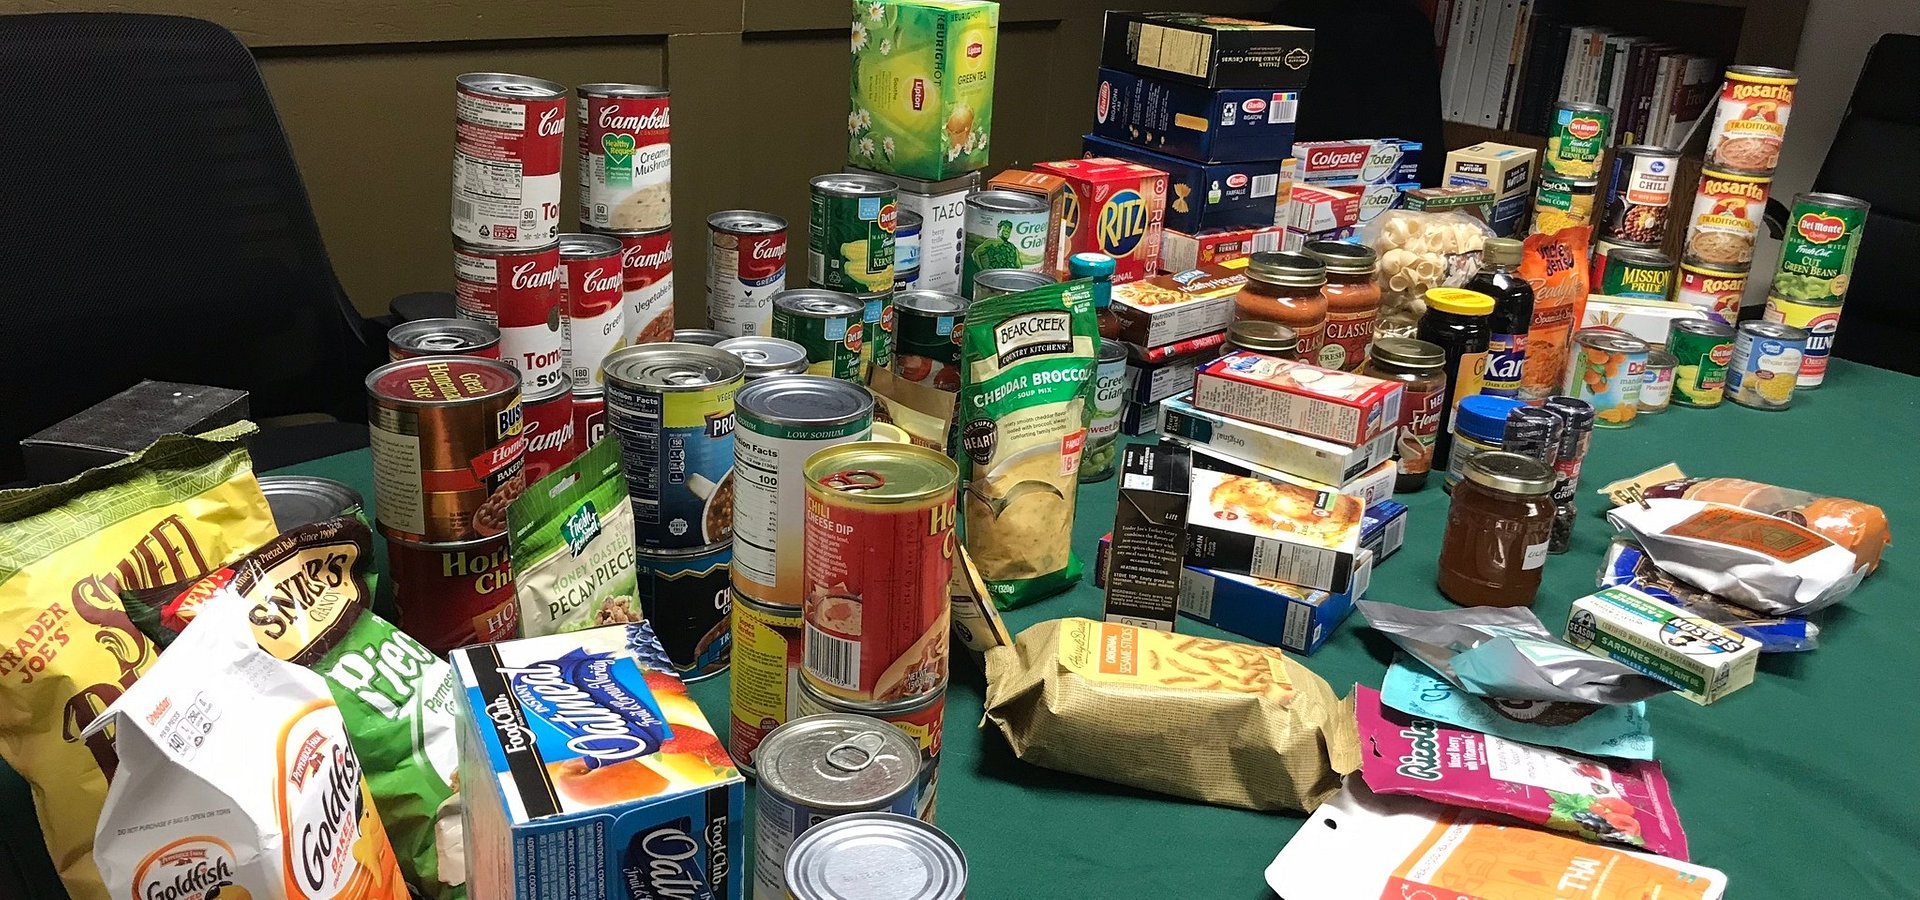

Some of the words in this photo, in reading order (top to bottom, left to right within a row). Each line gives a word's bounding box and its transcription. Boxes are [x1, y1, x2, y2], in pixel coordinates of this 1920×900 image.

[968, 46, 982, 54] Lipton
[958, 73, 976, 85] GREEN
[977, 71, 987, 81] TEA
[914, 81, 923, 108] Lipton
[1733, 84, 1793, 103] Rosarita
[1110, 88, 1118, 121] RIGATONI
[1730, 122, 1782, 132] TRADITIONAL
[606, 140, 629, 148] Healthy
[1312, 151, 1363, 167] Colgate
[1369, 152, 1396, 165] Total
[1155, 178, 1165, 194] 8
[1226, 188, 1246, 196] FARFALLE
[1639, 181, 1667, 191] CHILI
[1705, 180, 1764, 199] Rosarita
[1364, 194, 1393, 205] Total
[524, 210, 533, 219] 90
[933, 202, 965, 222] TAZO
[1099, 198, 1147, 248] RITZ
[1147, 197, 1163, 256] FRESH
[1701, 216, 1752, 228] TRADITIONAL
[1801, 219, 1813, 230] Del
[1814, 223, 1842, 234] Monte
[1218, 243, 1239, 253] TURKEY
[1537, 241, 1566, 259] Uncle
[1796, 244, 1813, 254] Fresh
[1814, 248, 1831, 257] Cut
[1784, 261, 1809, 274] GREEN
[1810, 266, 1838, 278] BEANS
[1801, 256, 1821, 266] CUT
[1622, 267, 1670, 286] MISSION
[1631, 282, 1662, 293] PRIDE
[635, 286, 668, 314] Vegetable
[1152, 320, 1166, 328] Facts
[1153, 311, 1176, 321] Nutrition
[1001, 323, 1030, 344] BEAR
[1028, 317, 1066, 336] CREEK
[1327, 320, 1375, 338] CLASSIC
[1192, 334, 1221, 349] SPAGHETTI
[1762, 342, 1782, 350] Great
[1002, 349, 1028, 364] COUNTRY
[1030, 343, 1068, 354] KITCHENS
[1320, 352, 1345, 361] FRESH
[574, 369, 587, 377] 180
[458, 372, 487, 394] Great
[973, 375, 1027, 408] CHEDDAR
[636, 396, 658, 406] Facts
[1017, 391, 1035, 399] SOUP
[1038, 387, 1052, 395] MIX
[974, 420, 994, 428] SUPER
[1035, 413, 1054, 422] cheddar
[786, 431, 806, 439] LOW
[808, 428, 844, 438] SODIUM
[1006, 426, 1023, 434] loaded
[1010, 431, 1035, 441] comforting
[1036, 429, 1049, 437] family
[1216, 432, 1245, 447] Original
[752, 445, 778, 457] Facts
[759, 475, 777, 485] 100
[808, 497, 830, 519] CHILI
[1165, 512, 1178, 520] Lift
[568, 505, 596, 534] Fresh
[808, 510, 834, 531] CHEESE
[836, 523, 854, 535] DIP
[259, 543, 282, 566] Pretzel
[300, 533, 319, 543] Since
[1194, 535, 1204, 558] SPAIN
[552, 563, 589, 594] HONEY
[589, 535, 629, 568] ROASTED
[1139, 567, 1168, 575] INSTRUCTIONS
[549, 575, 596, 622] PECAN
[999, 585, 1015, 594] (320g)
[1119, 627, 1132, 648] STICKS
[1569, 621, 1595, 640] SEASON
[1602, 622, 1627, 639] CERTIFIED
[1628, 634, 1641, 645] WILD
[1643, 640, 1663, 654] CAUGHT
[1672, 618, 1740, 652] SEASON
[22, 622, 70, 684] JOE'S
[1104, 635, 1117, 663] ORIGINAL
[1601, 636, 1650, 664] SARDINES
[1660, 663, 1674, 675] 100%
[1674, 669, 1690, 681] OLIVE
[1119, 649, 1132, 673] SESAME
[1613, 653, 1641, 670] SKINLESS
[1648, 671, 1681, 688] BONELESS
[517, 684, 550, 714] INSTANT
[146, 696, 172, 725] Cheddar
[485, 693, 517, 727] Club
[496, 662, 647, 760] Oatmeal
[169, 733, 184, 753] 140
[501, 721, 537, 754] Food
[1447, 735, 1462, 752] Berry
[291, 748, 313, 784] PEPPERIDGE
[307, 731, 327, 751] FARM
[1396, 720, 1443, 781] Ricola
[1462, 739, 1478, 761] Vitamin
[139, 821, 166, 831] PURCHASE
[191, 812, 206, 821] OPEN
[331, 810, 353, 874] BAKED
[712, 816, 727, 851] Food
[147, 856, 231, 900] Goldfish
[712, 852, 728, 885] Club
[1557, 856, 1603, 893] THAI
